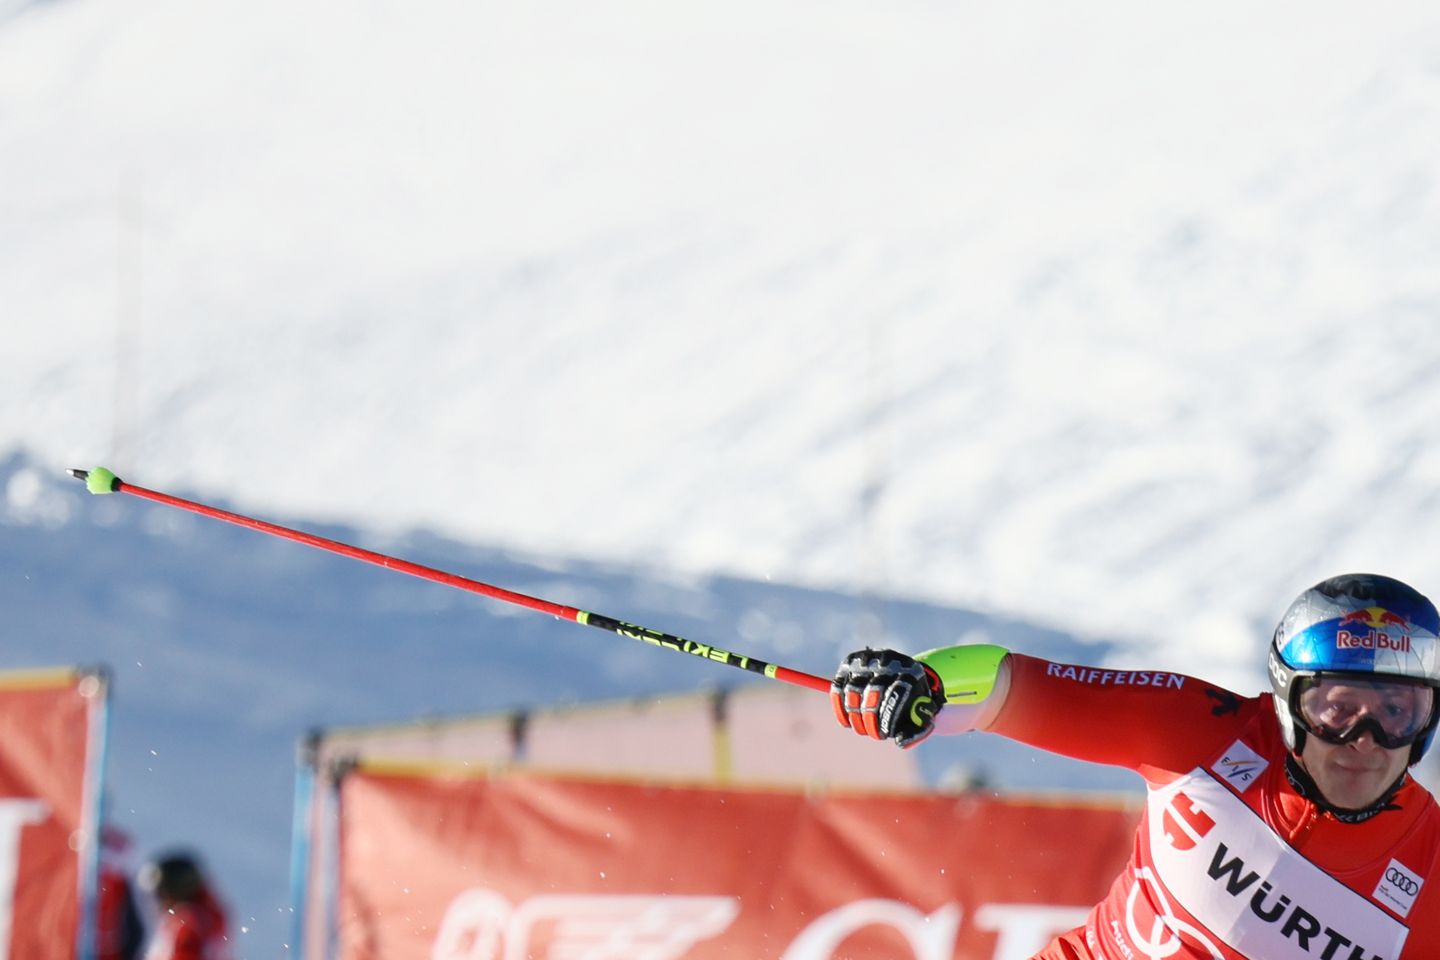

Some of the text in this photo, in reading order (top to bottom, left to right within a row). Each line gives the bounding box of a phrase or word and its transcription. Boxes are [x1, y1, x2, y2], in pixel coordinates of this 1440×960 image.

[1336, 630, 1412, 653] Red Bull
[1046, 662, 1186, 690] RAIFFEISEN
